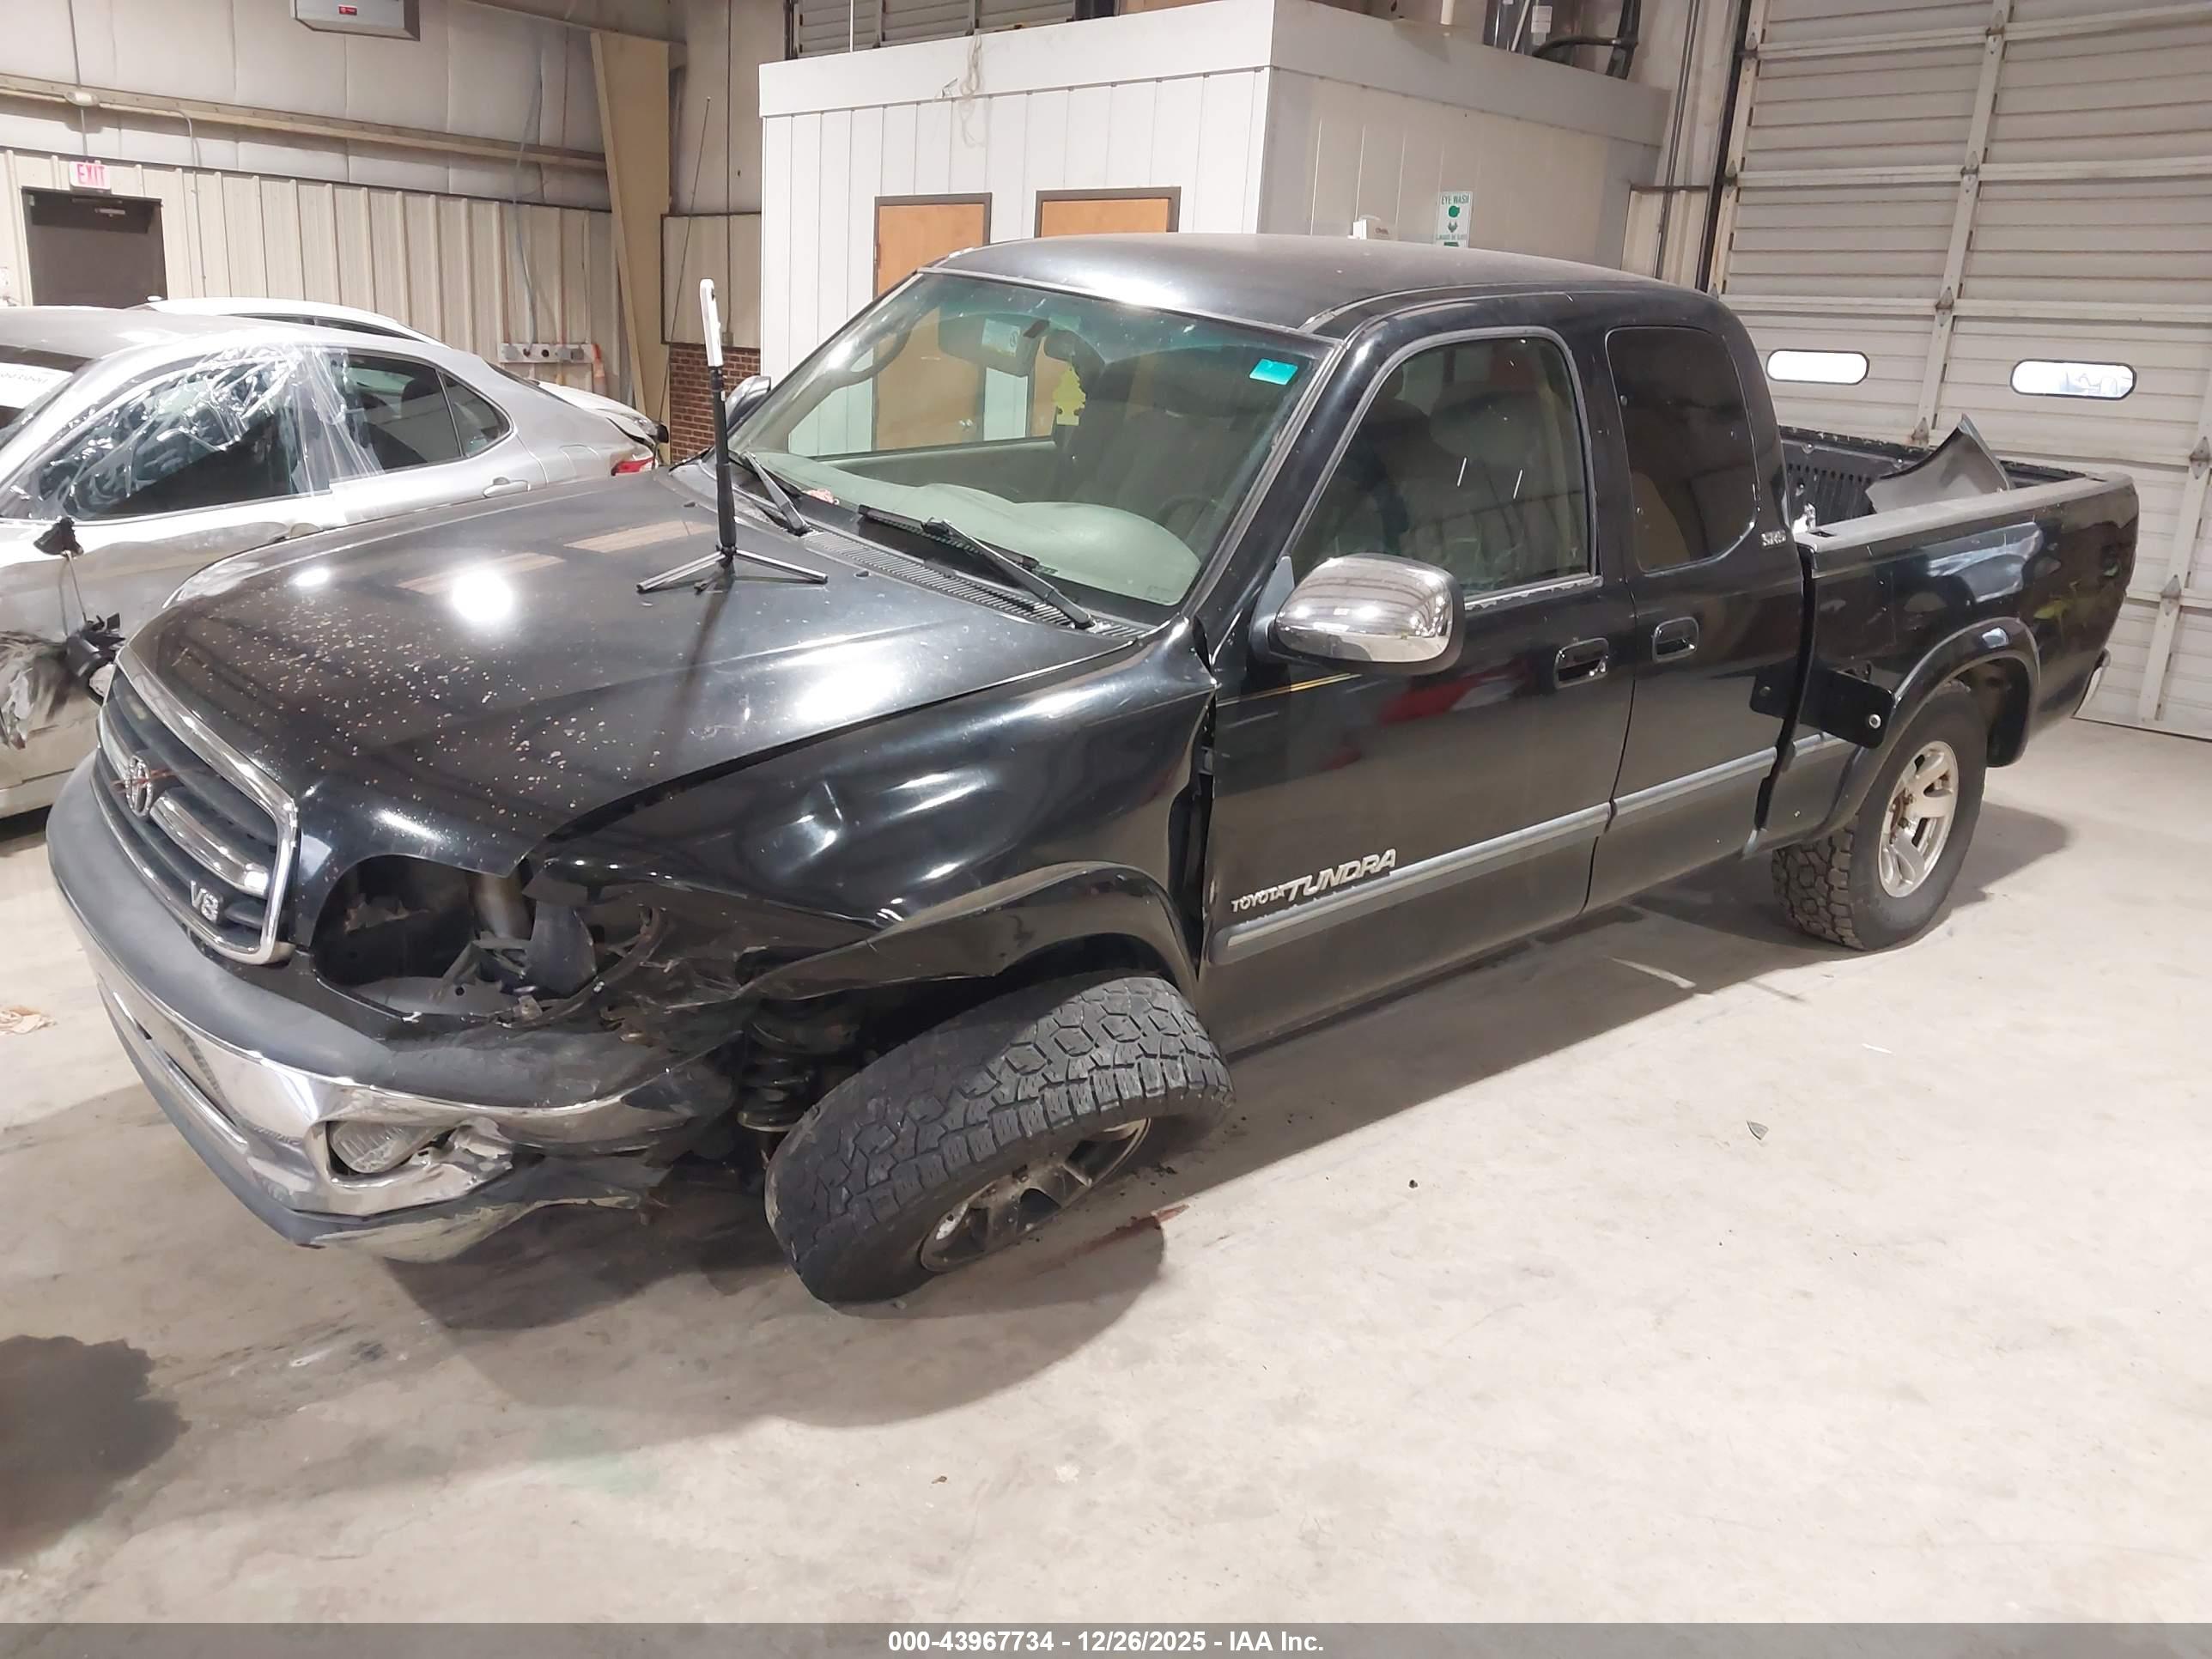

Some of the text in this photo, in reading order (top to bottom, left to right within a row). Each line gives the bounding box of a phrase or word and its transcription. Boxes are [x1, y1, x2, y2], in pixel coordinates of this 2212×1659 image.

[76, 163, 105, 186] EXIT
[1441, 194, 1469, 205] EYE WASH
[1231, 848, 1397, 913] TOYOTA TUNDRA
[190, 879, 220, 923] V8
